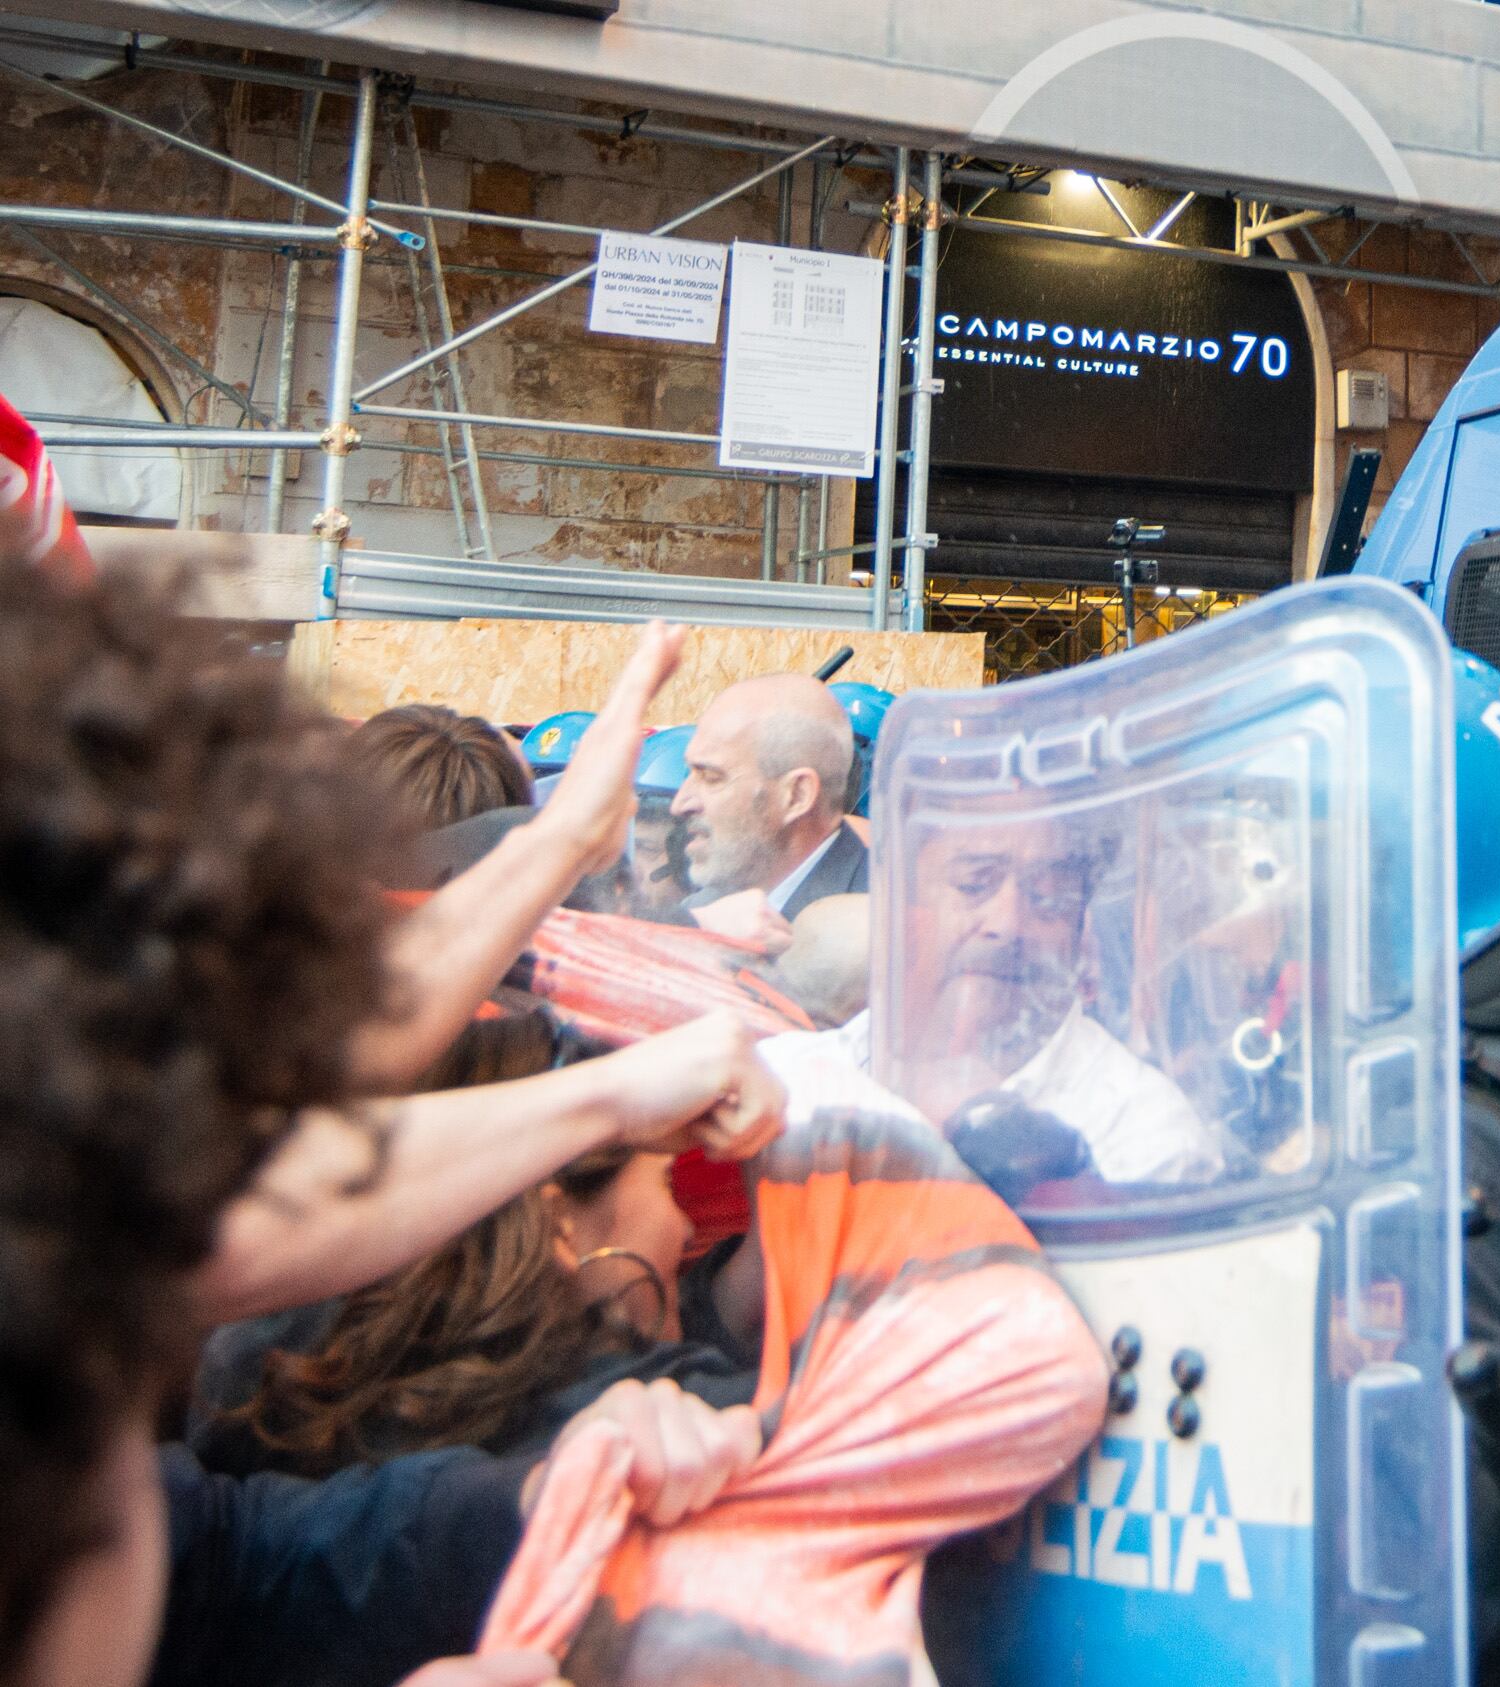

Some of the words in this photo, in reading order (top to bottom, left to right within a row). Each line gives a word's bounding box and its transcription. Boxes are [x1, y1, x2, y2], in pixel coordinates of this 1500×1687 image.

[604, 245, 661, 265] URBAN
[667, 251, 723, 272] VISION
[618, 284, 660, 295] 01/10/2024
[939, 314, 1220, 360] CAMPOMARZIO
[1232, 334, 1287, 377] 70
[938, 347, 1046, 368] ESSENTIAL
[1057, 358, 1139, 377] CULTURE
